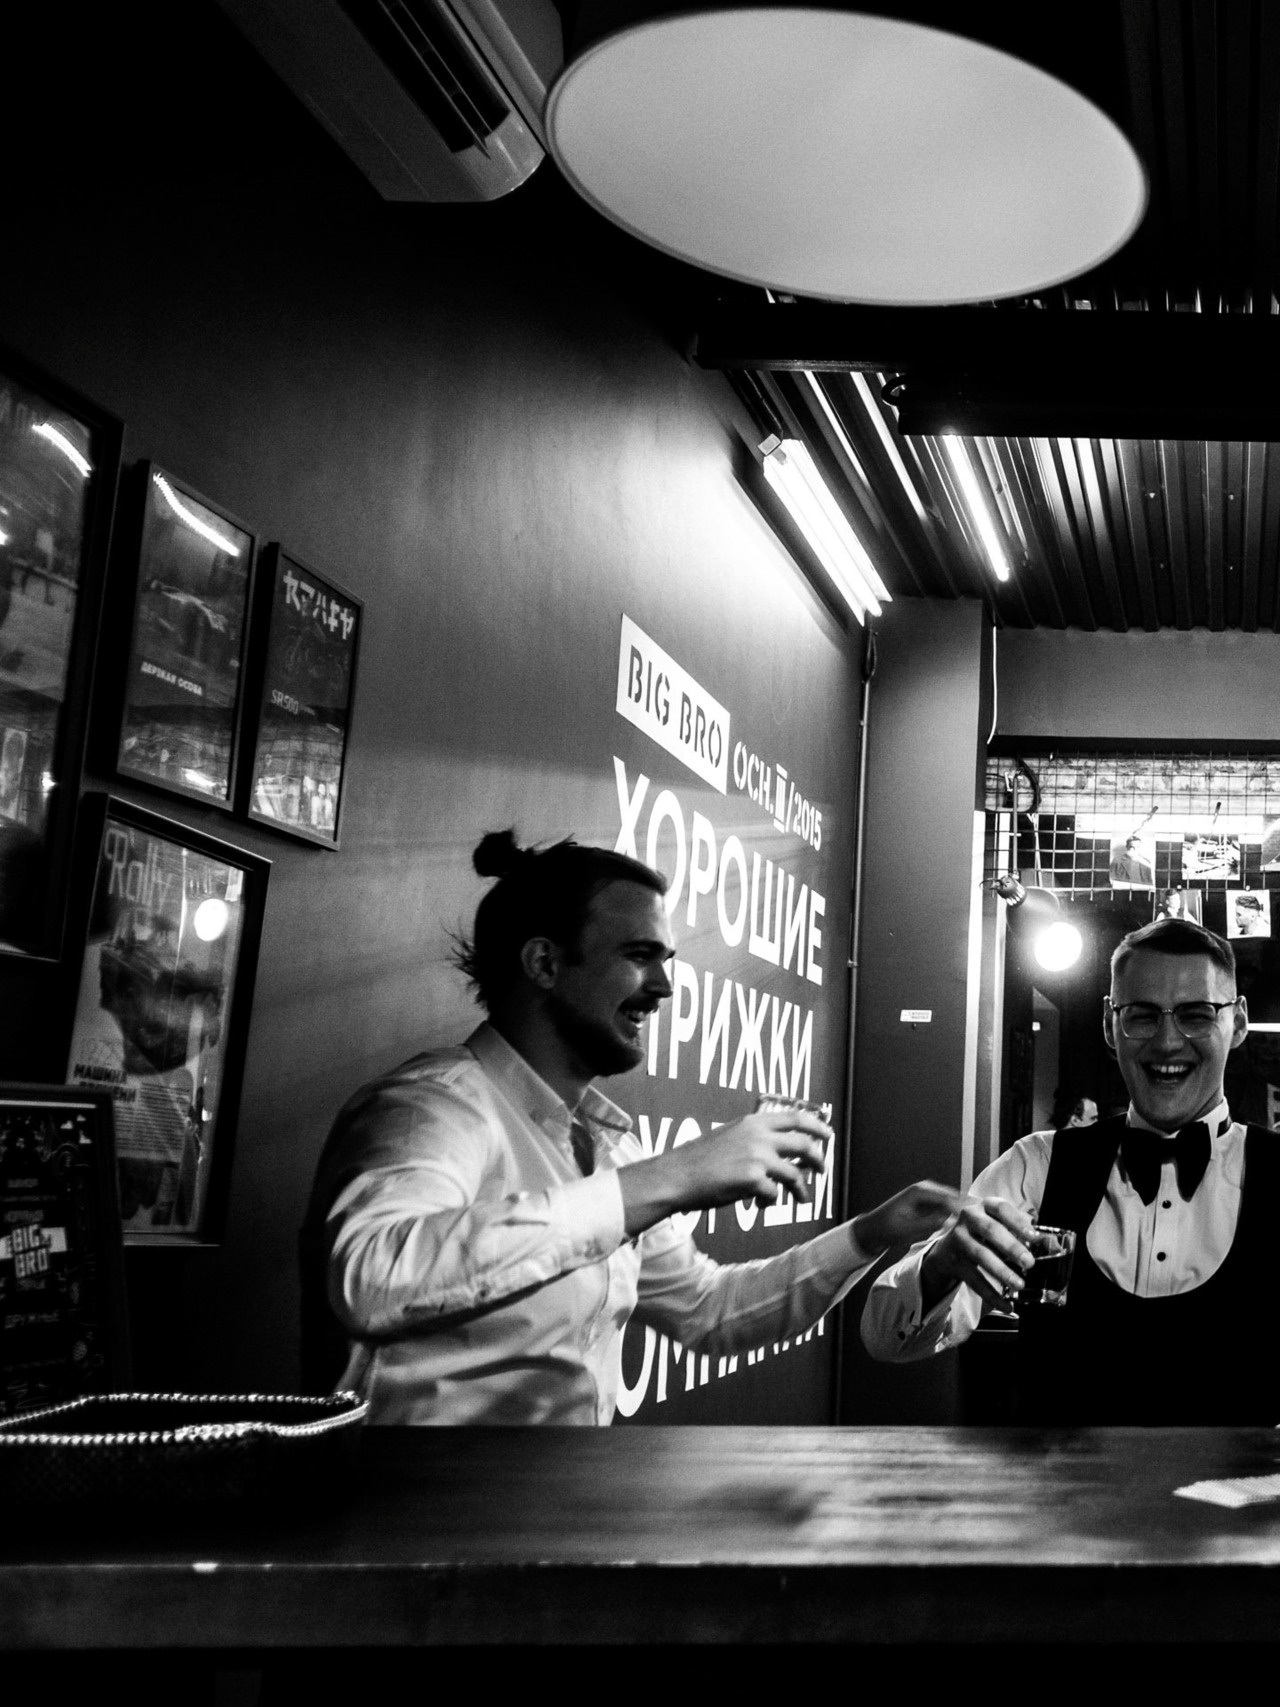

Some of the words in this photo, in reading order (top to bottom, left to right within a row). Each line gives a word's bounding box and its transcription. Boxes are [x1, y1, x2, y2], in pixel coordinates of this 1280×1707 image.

[628, 644, 670, 726] BIG
[679, 691, 722, 768] BRO
[613, 755, 826, 986] ХОРОШИЕ
[648, 958, 813, 1101] ТРИЖКИ
